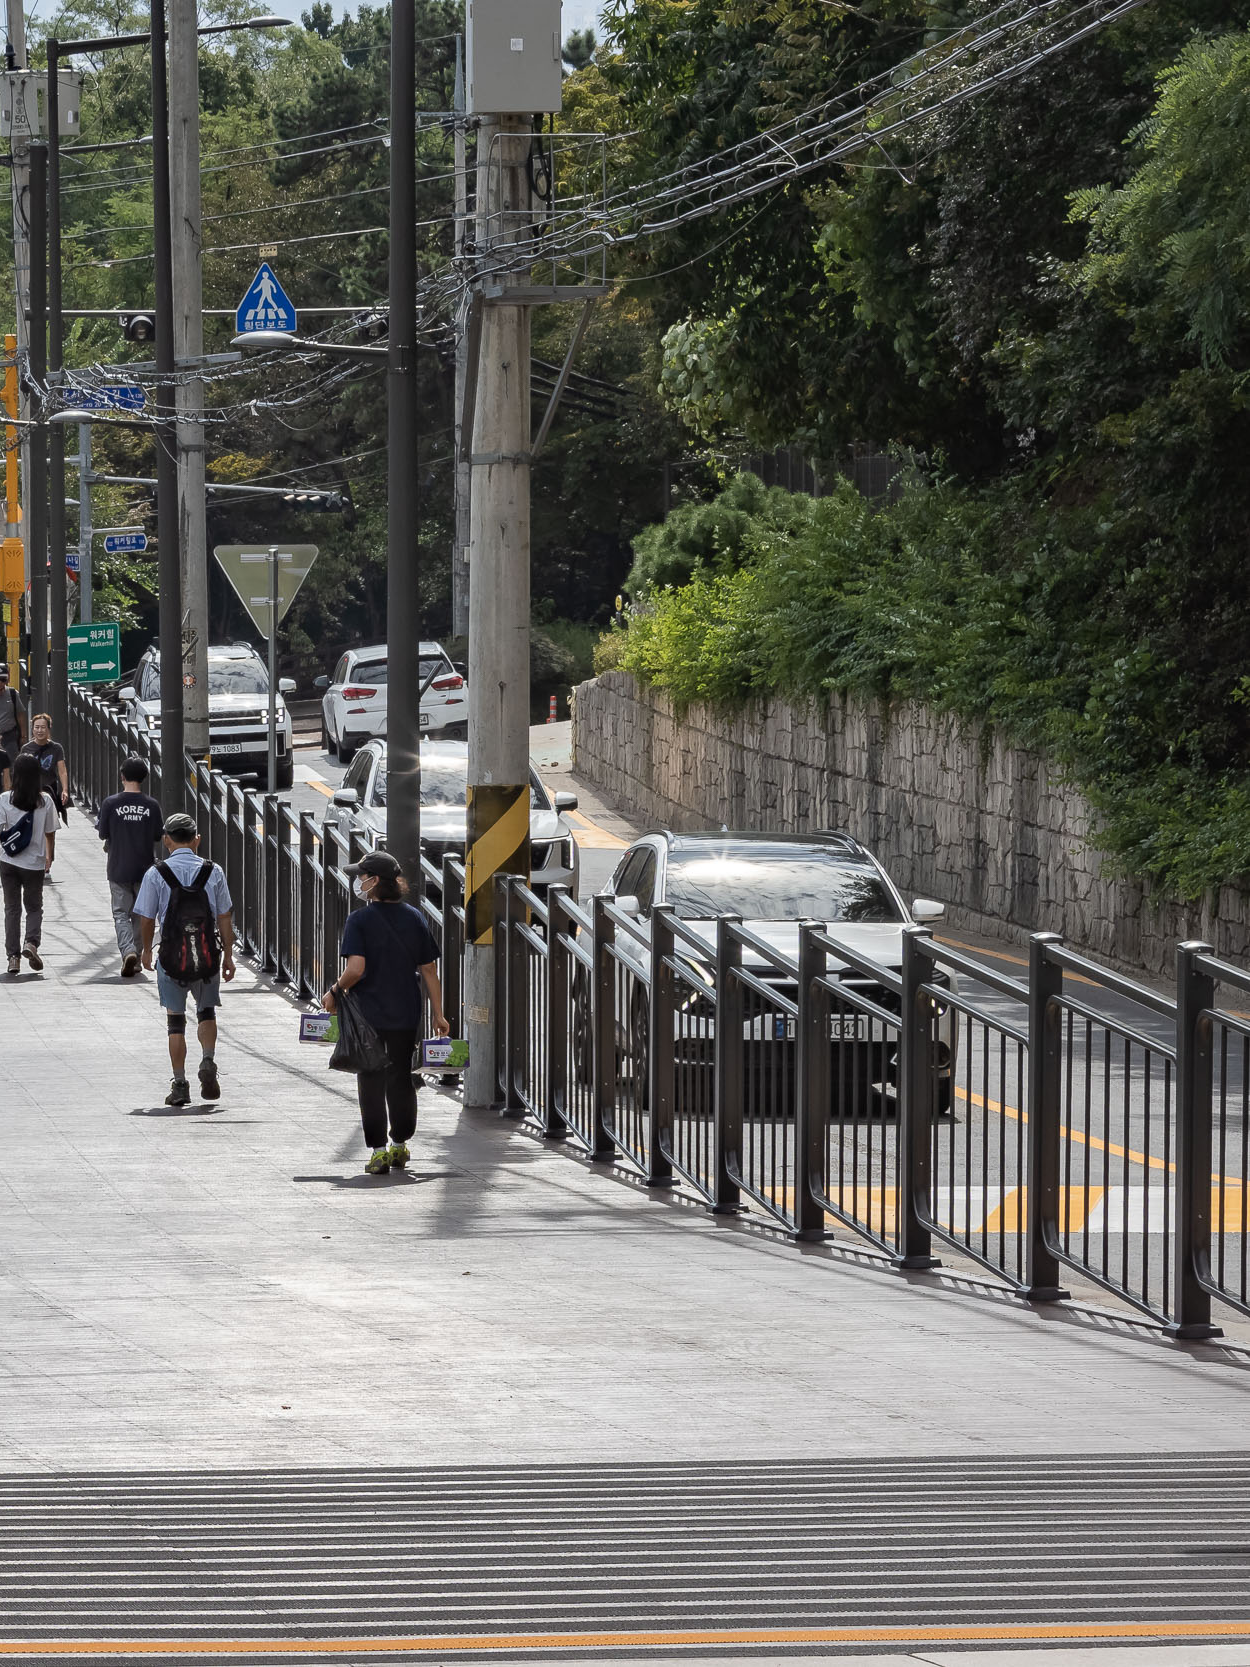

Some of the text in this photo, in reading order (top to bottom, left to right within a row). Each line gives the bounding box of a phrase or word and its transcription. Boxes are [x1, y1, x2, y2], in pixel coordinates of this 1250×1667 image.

[15, 115, 26, 124] 50
[244, 320, 287, 331] 횡단보도
[90, 628, 114, 640] 워커힐
[90, 640, 114, 648] Walkerhill
[223, 745, 240, 753] 1083
[115, 805, 150, 817] KOREA
[123, 814, 143, 822] ARMY
